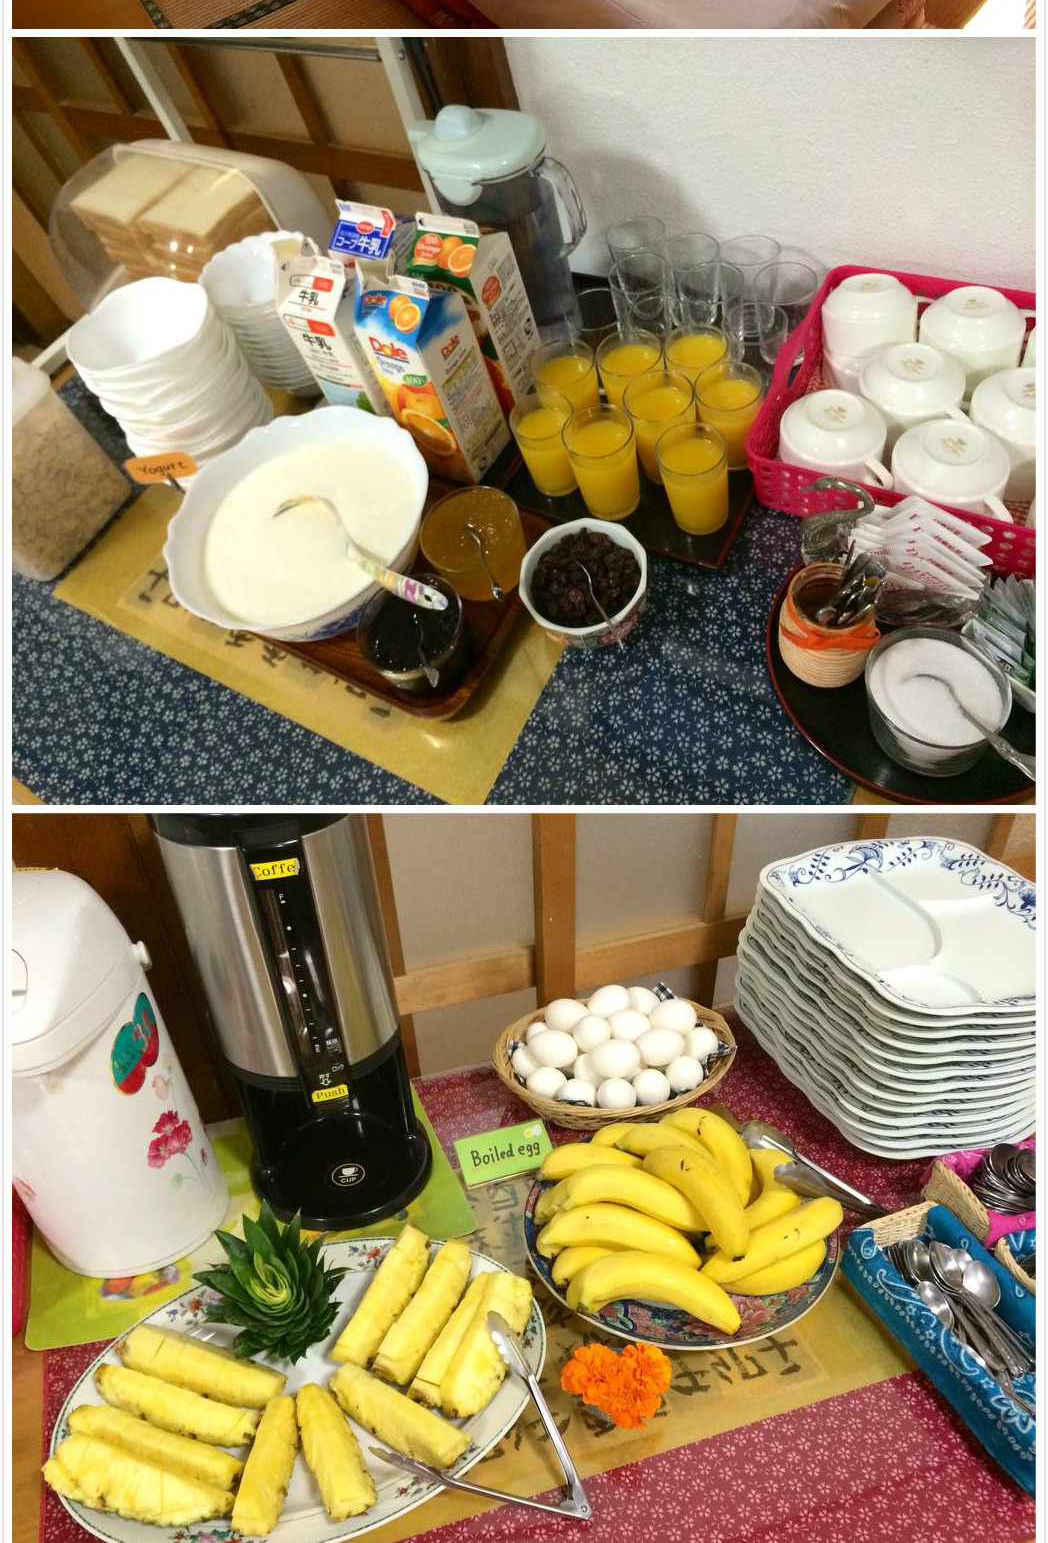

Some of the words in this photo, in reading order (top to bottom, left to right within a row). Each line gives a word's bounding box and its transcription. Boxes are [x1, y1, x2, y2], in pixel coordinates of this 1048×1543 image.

[298, 289, 319, 306] 牛乳
[302, 333, 332, 351] 牛乳
[368, 336, 408, 360] Dole
[137, 461, 188, 477] Yogurt
[316, 1087, 346, 1100] Push
[470, 1143, 515, 1167] Boiled
[518, 1142, 541, 1158] egg
